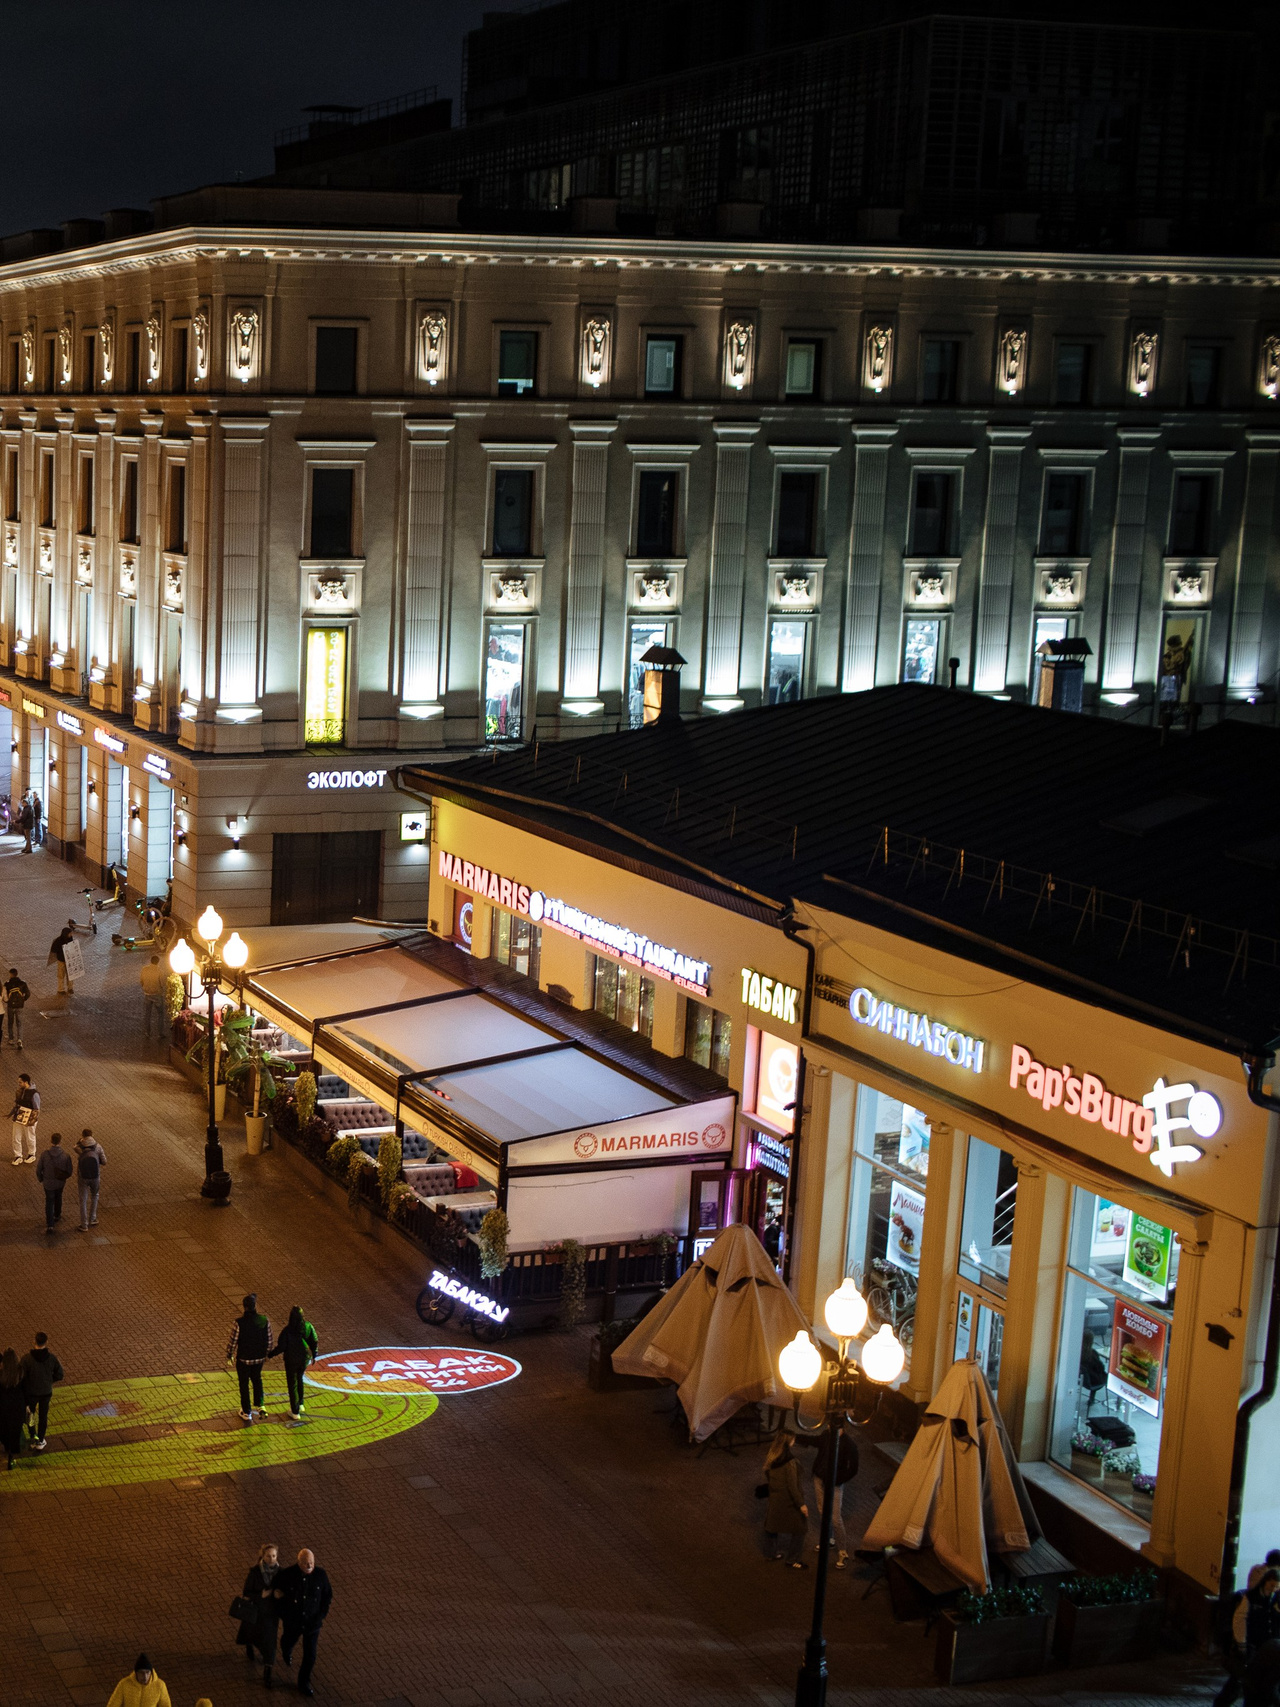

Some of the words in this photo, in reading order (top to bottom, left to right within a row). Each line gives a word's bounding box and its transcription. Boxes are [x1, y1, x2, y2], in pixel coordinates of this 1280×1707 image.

[307, 770, 387, 789] ЭКОЛОФТ
[439, 850, 530, 915] MARMARIS
[741, 967, 799, 1025] ТАБАК
[849, 987, 985, 1074] СИННАБОН
[601, 1131, 699, 1152] MARMARIS
[1122, 1308, 1158, 1333] ЛЮБИМЫЕ
[1126, 1319, 1153, 1339] КОМБО
[328, 1355, 495, 1374] ТАБАК
[343, 1364, 507, 1385] НАПИТКИ
[426, 1378, 468, 1388] 24
